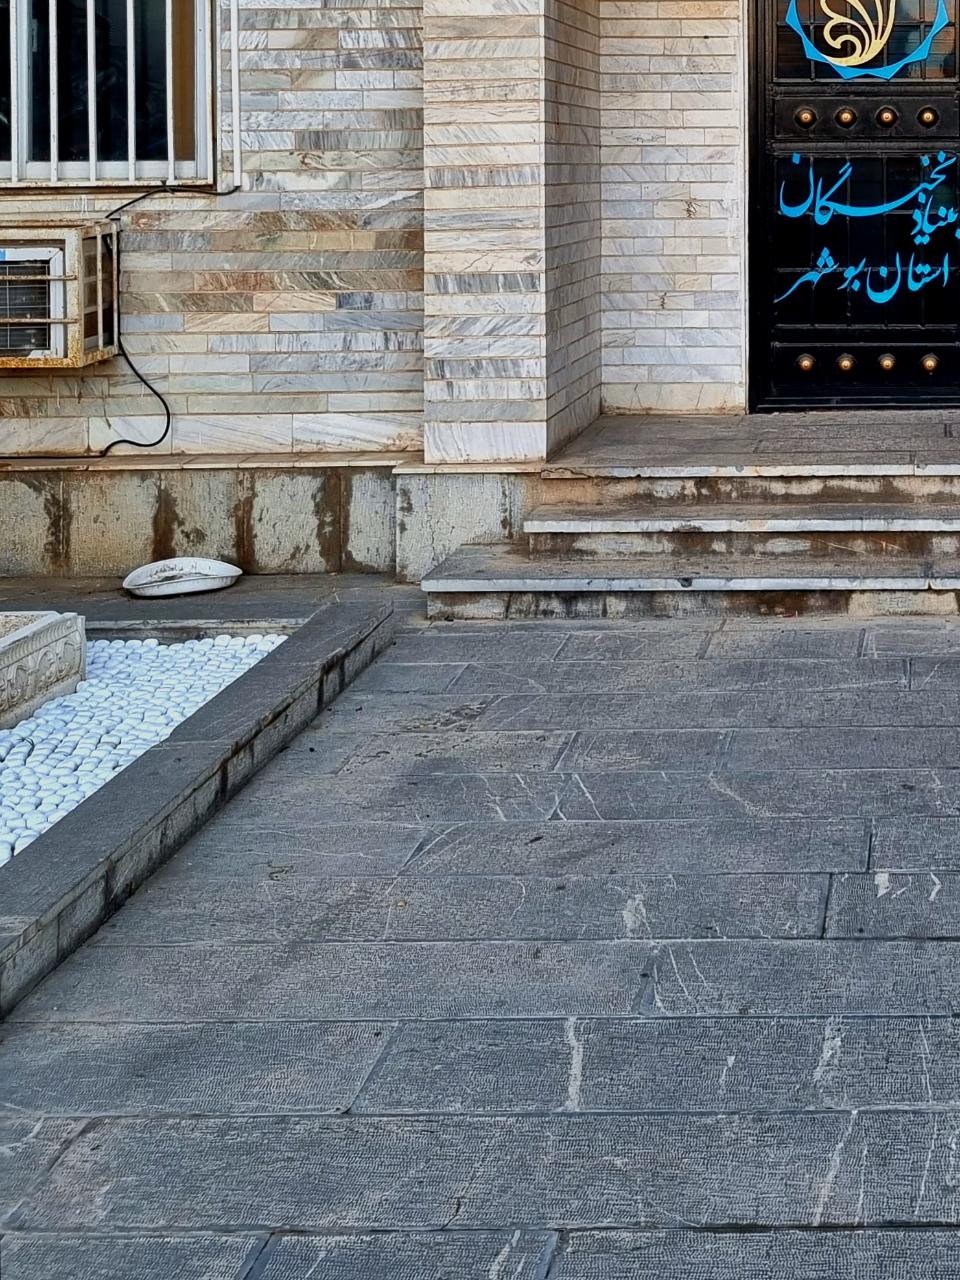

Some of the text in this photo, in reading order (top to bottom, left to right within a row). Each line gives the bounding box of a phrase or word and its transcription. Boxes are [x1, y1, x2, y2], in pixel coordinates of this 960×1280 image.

[779, 150, 957, 226] نخبگان
[773, 246, 949, 304] استان بوشهر
